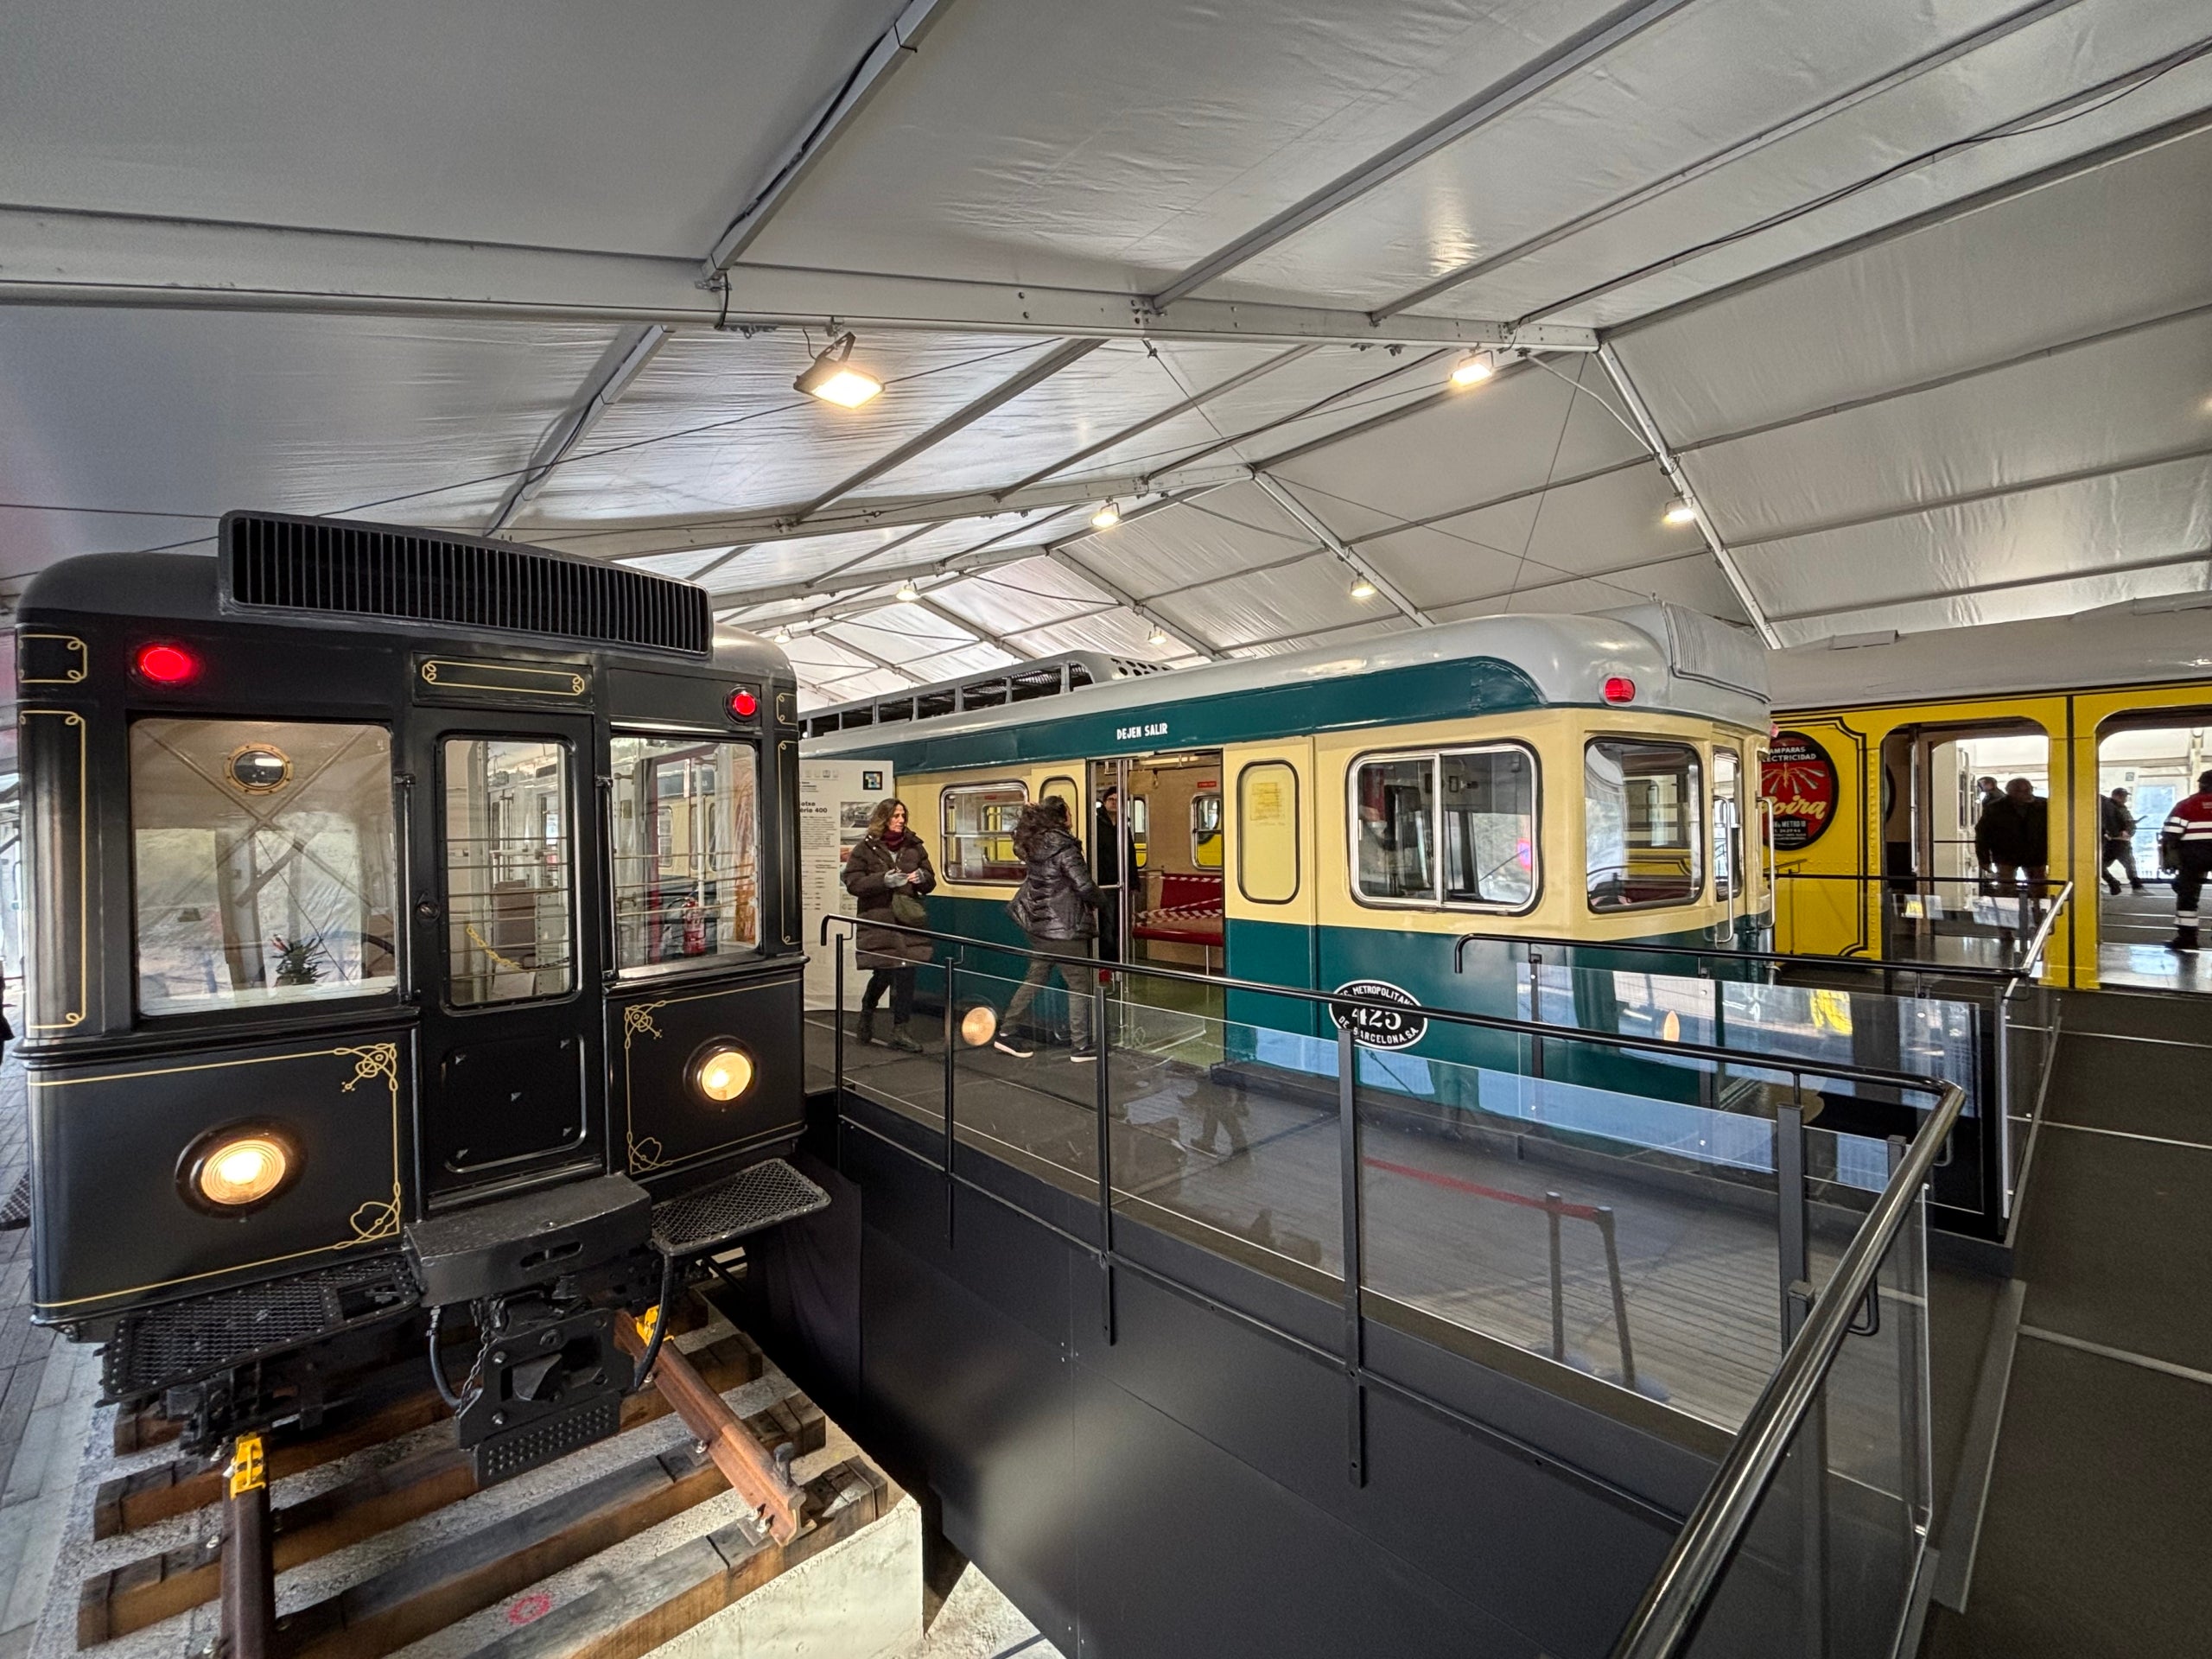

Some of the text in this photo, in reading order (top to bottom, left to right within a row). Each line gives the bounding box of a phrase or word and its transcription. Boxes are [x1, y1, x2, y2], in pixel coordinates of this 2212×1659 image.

[1116, 722, 1168, 740] DEJEN SALIR
[1763, 753, 1816, 762] ECTRICIDAD
[1352, 985, 1414, 1005] METROPOLITAN
[1338, 1015, 1350, 1029] DE
[1351, 1007, 1402, 1031] 425
